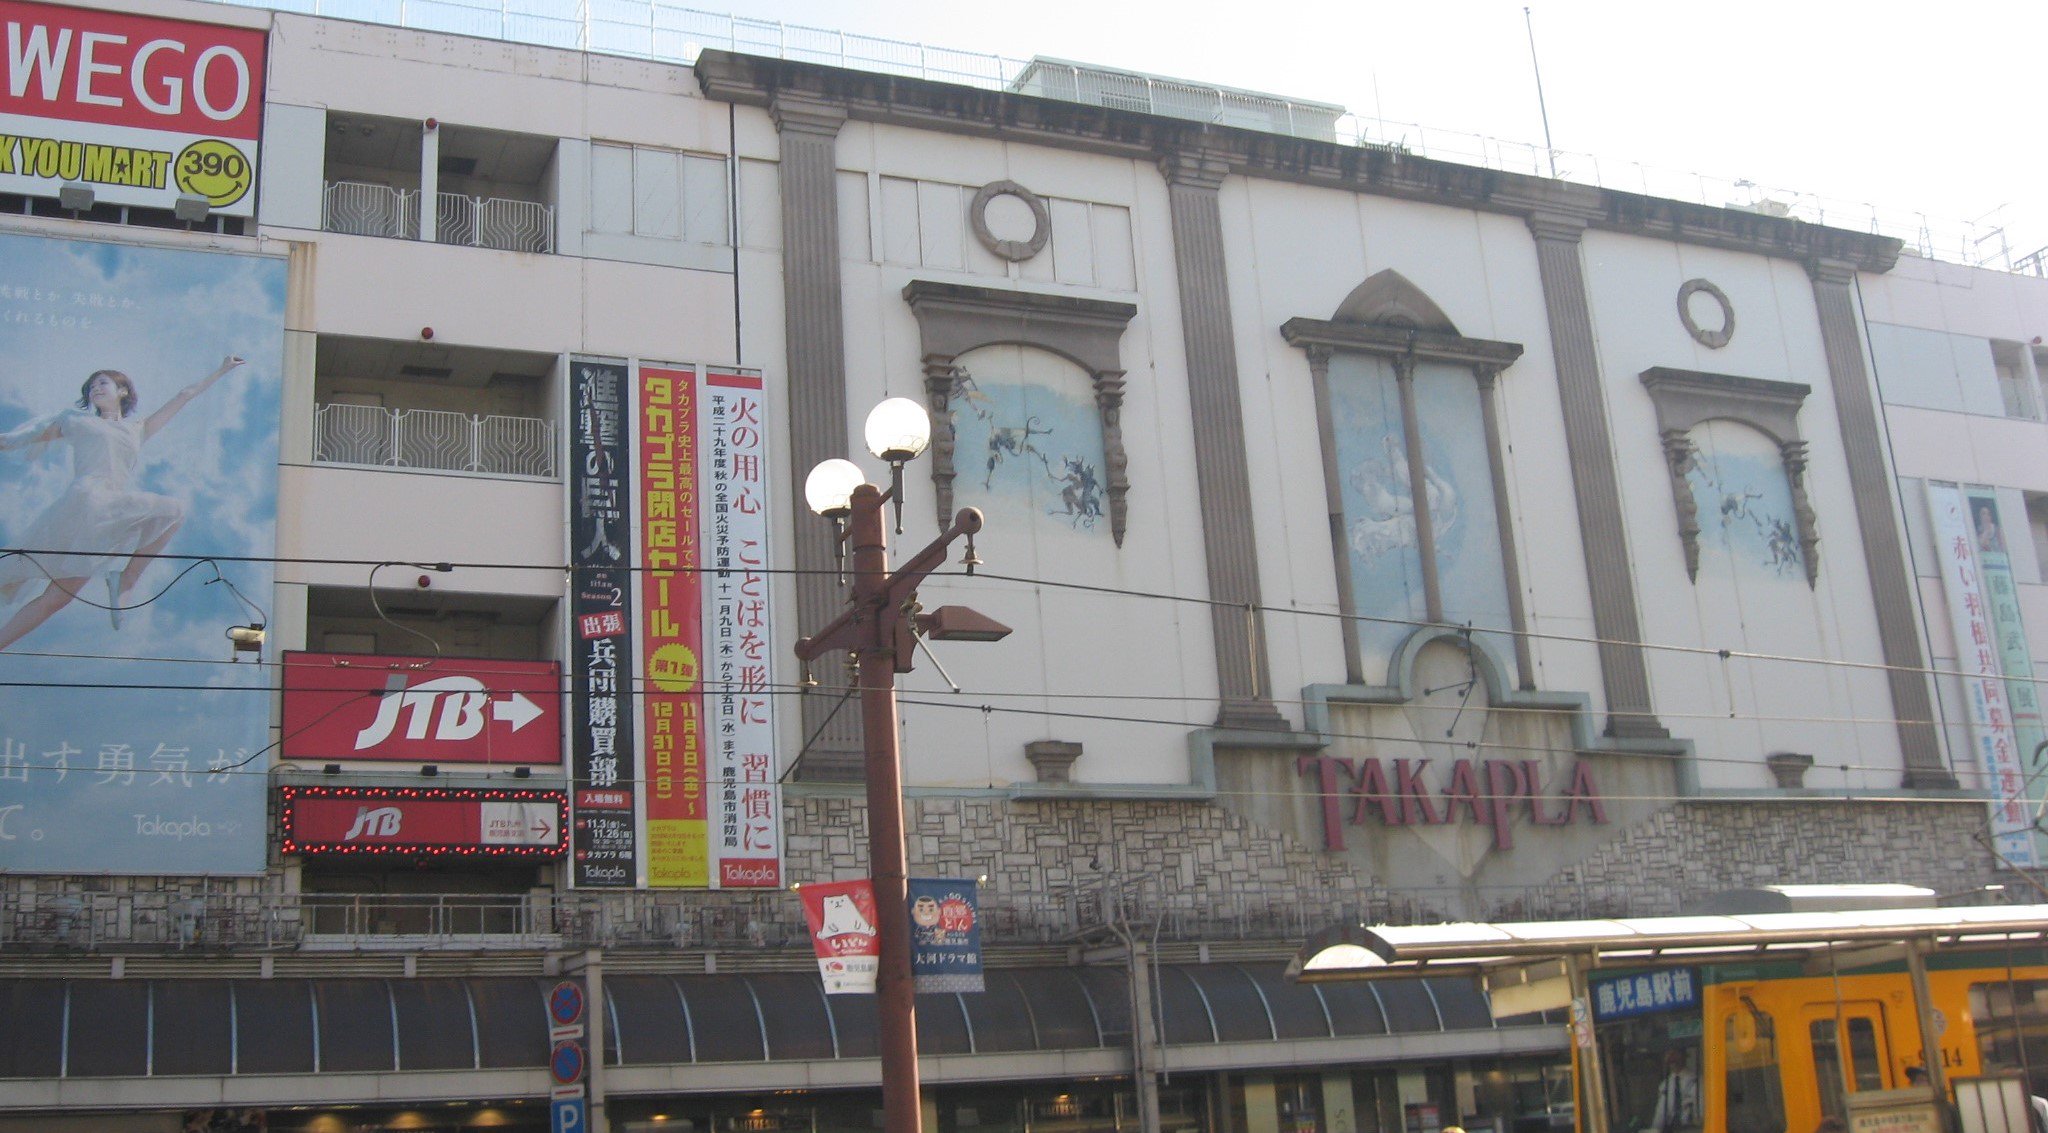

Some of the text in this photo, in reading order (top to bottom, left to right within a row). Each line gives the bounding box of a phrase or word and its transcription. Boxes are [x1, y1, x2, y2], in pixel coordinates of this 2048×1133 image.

[7, 21, 250, 122] WEGO
[20, 138, 83, 181] YOU
[83, 143, 173, 189] MART
[184, 151, 245, 178] 390
[677, 379, 696, 584] タカプラ史上最高のセールです。
[645, 376, 679, 638] タカプラ閉店セール
[610, 587, 623, 607] 2
[583, 613, 622, 635] 出張
[712, 396, 731, 578] 平成二十九年度秋の全国火災予防運動
[722, 766, 738, 848] 鹿児島市消防局
[731, 397, 772, 852] 火の用心 ことばを形に 習慣に
[354, 674, 489, 751] JTB
[588, 637, 618, 787] 兵団購買部
[585, 793, 624, 804] 入場無料
[1297, 757, 1610, 852] TAKAPLA
[133, 814, 210, 841] Takapla
[344, 806, 403, 840] JTB
[584, 864, 626, 880] Takapla
[724, 863, 776, 884] Takapla
[916, 952, 977, 964] 大河ドラマ館
[1598, 968, 1693, 1015] 鹿児島駅前
[559, 1104, 578, 1133] P
